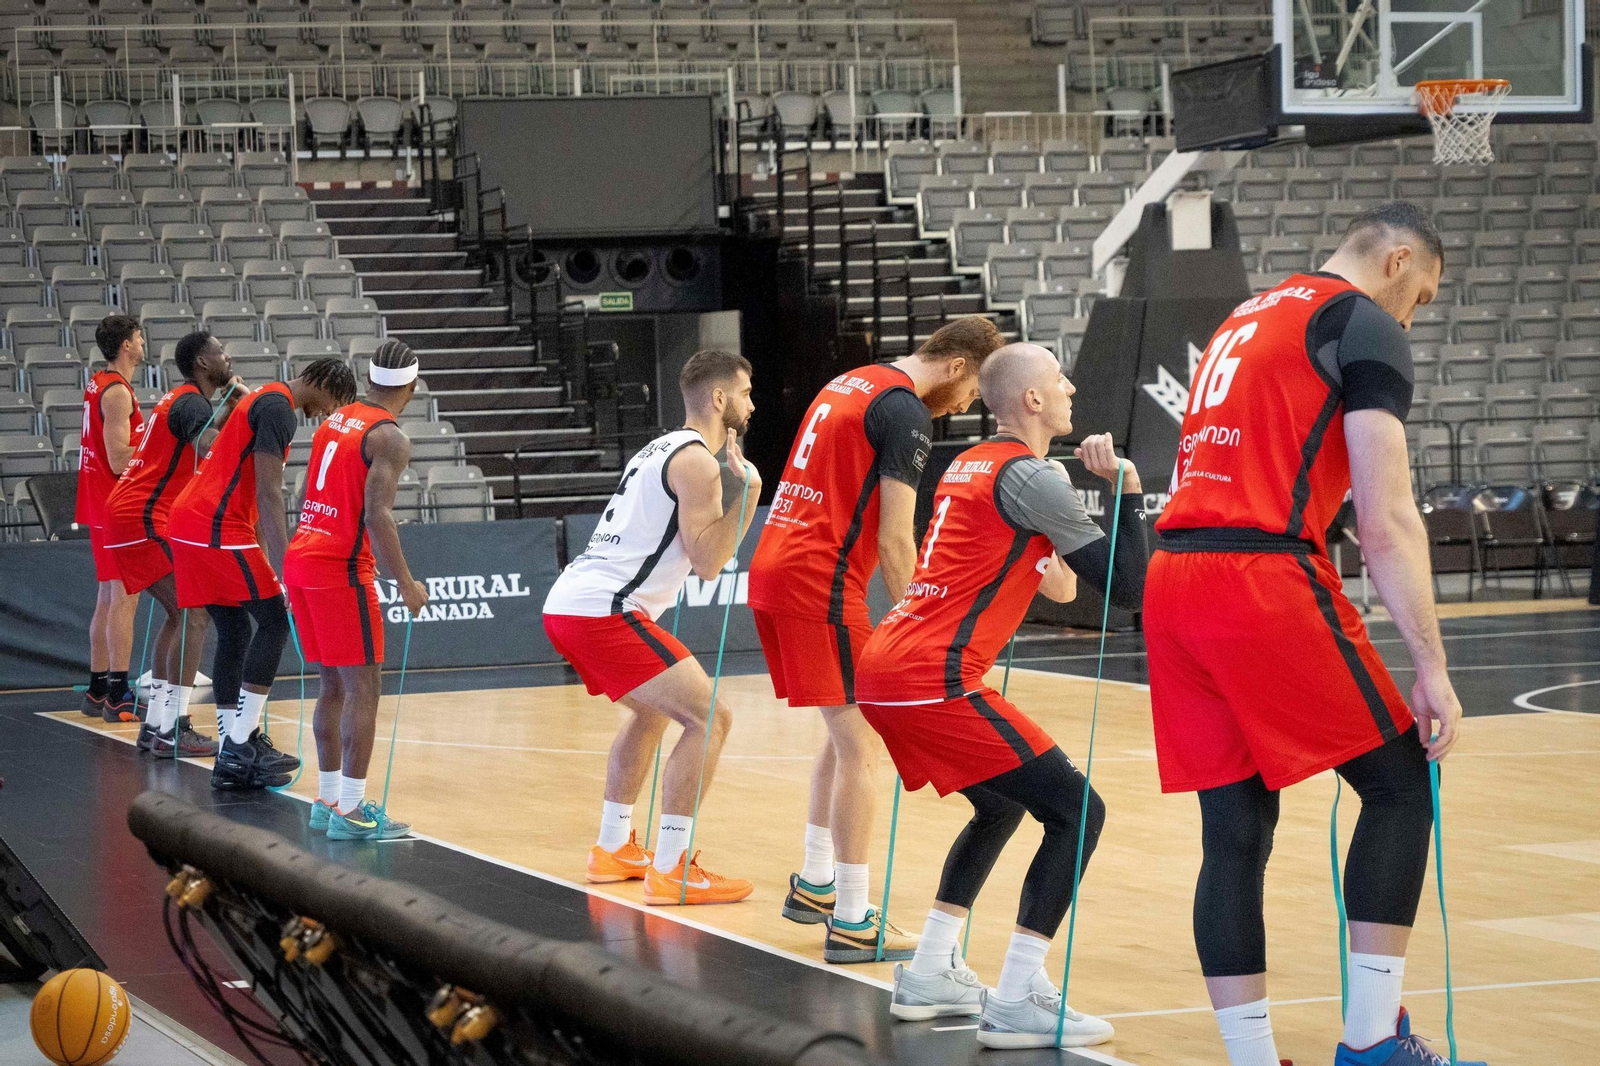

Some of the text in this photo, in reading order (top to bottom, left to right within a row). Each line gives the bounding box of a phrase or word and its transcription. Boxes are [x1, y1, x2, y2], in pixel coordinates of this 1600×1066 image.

[602, 297, 630, 306] SALIDA
[1191, 321, 1258, 415] 16
[793, 403, 832, 470] 6
[1182, 425, 1240, 451] GRNADA
[960, 460, 994, 474] RURAL
[1205, 472, 1232, 482] CULTURA
[774, 497, 794, 513] 031
[778, 481, 823, 505] RANADA
[426, 573, 530, 600] RURAL
